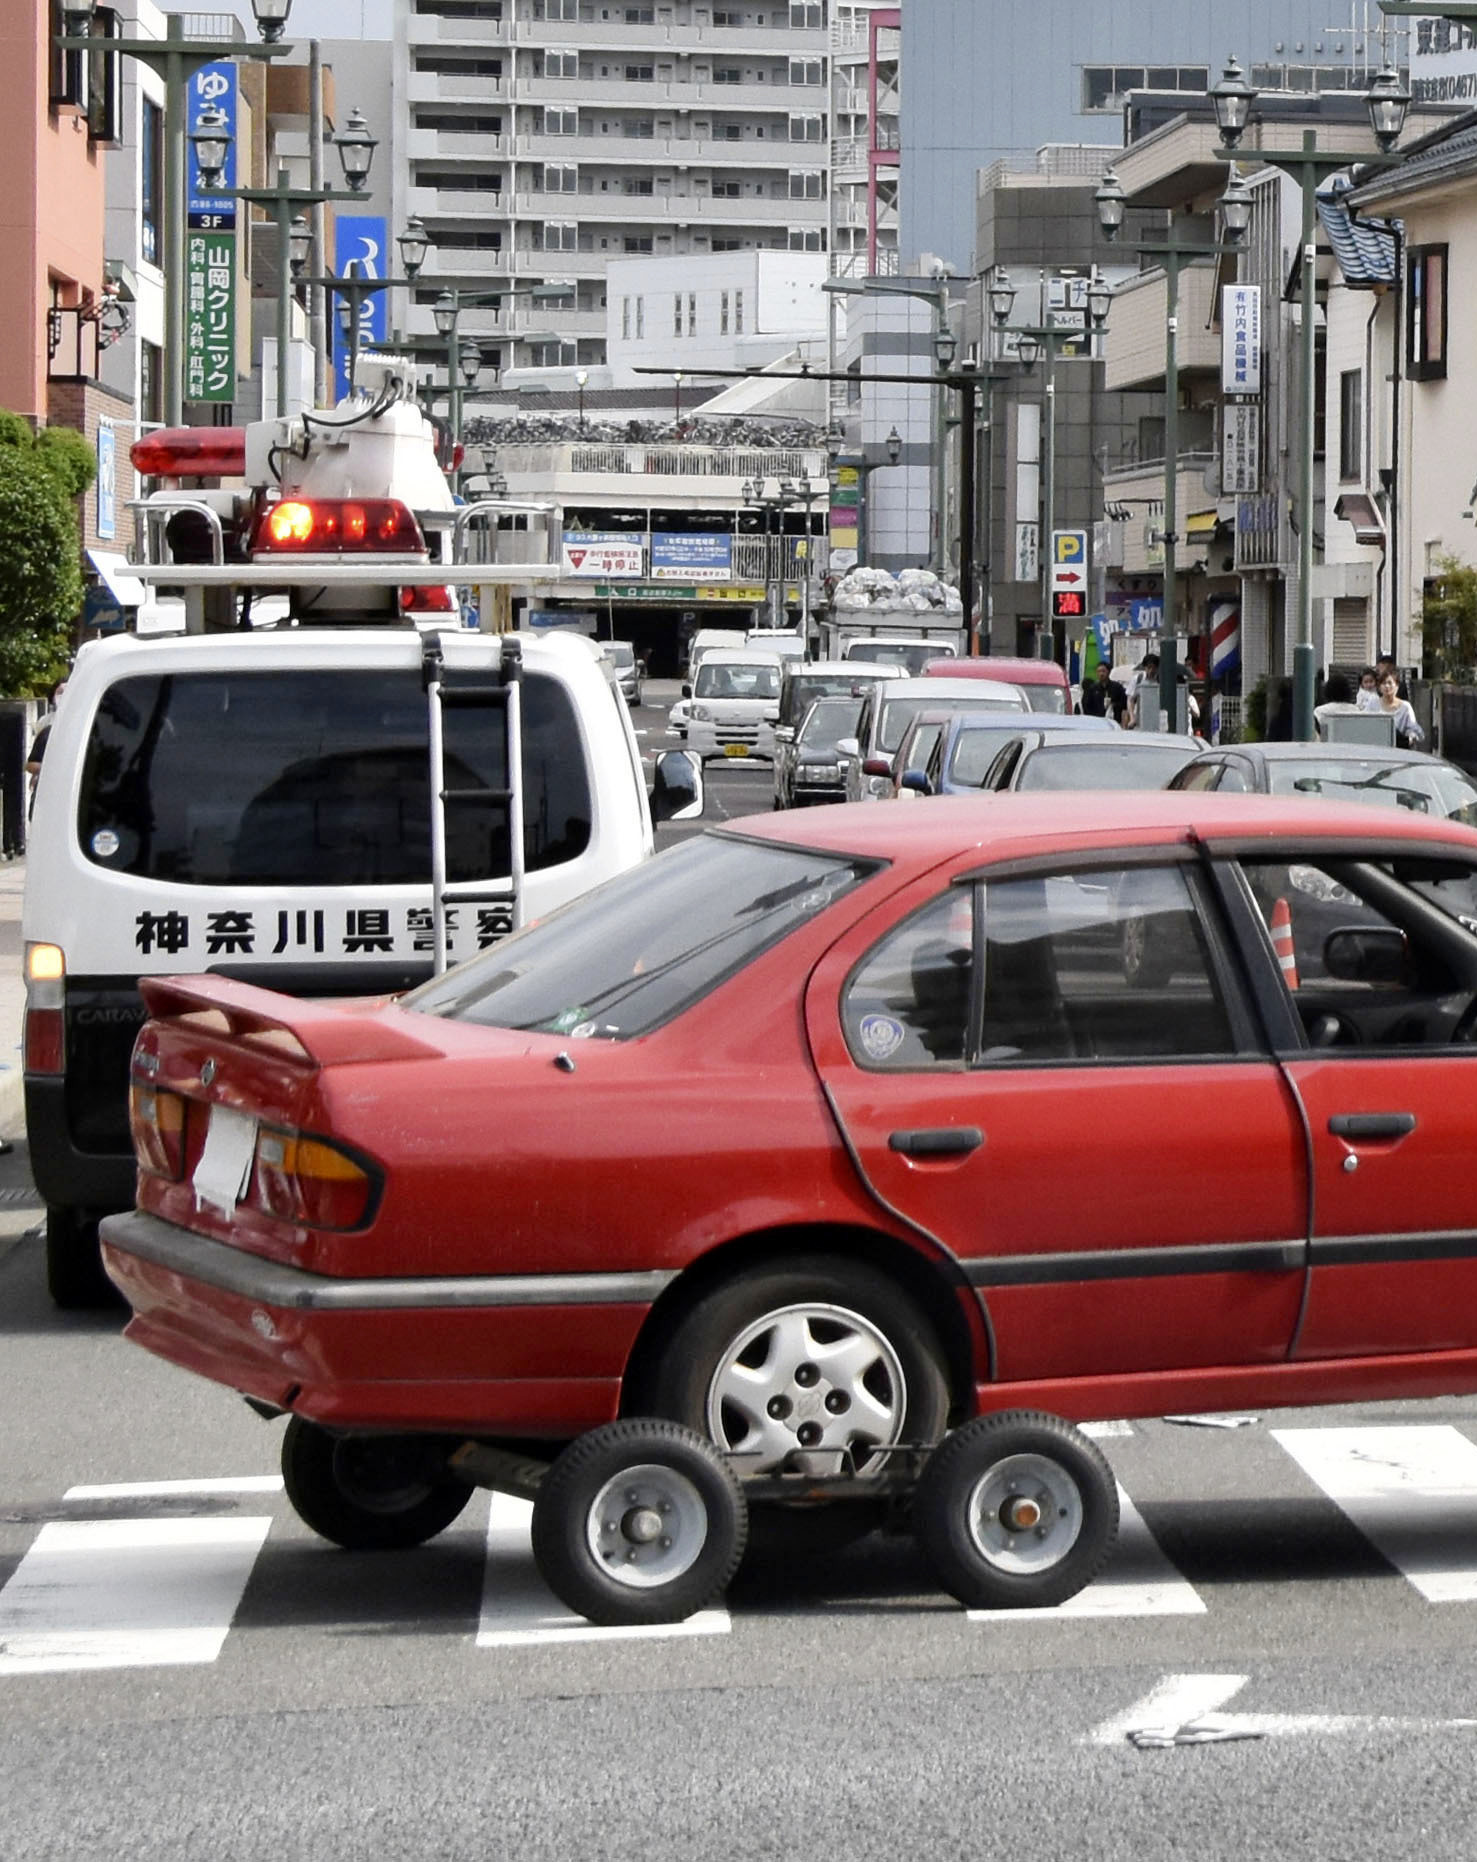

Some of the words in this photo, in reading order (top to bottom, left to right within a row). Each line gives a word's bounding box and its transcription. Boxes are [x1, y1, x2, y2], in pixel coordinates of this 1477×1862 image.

[200, 215, 223, 228] 3F
[207, 246, 230, 391] 山岡クリニック
[1057, 536, 1080, 562] P
